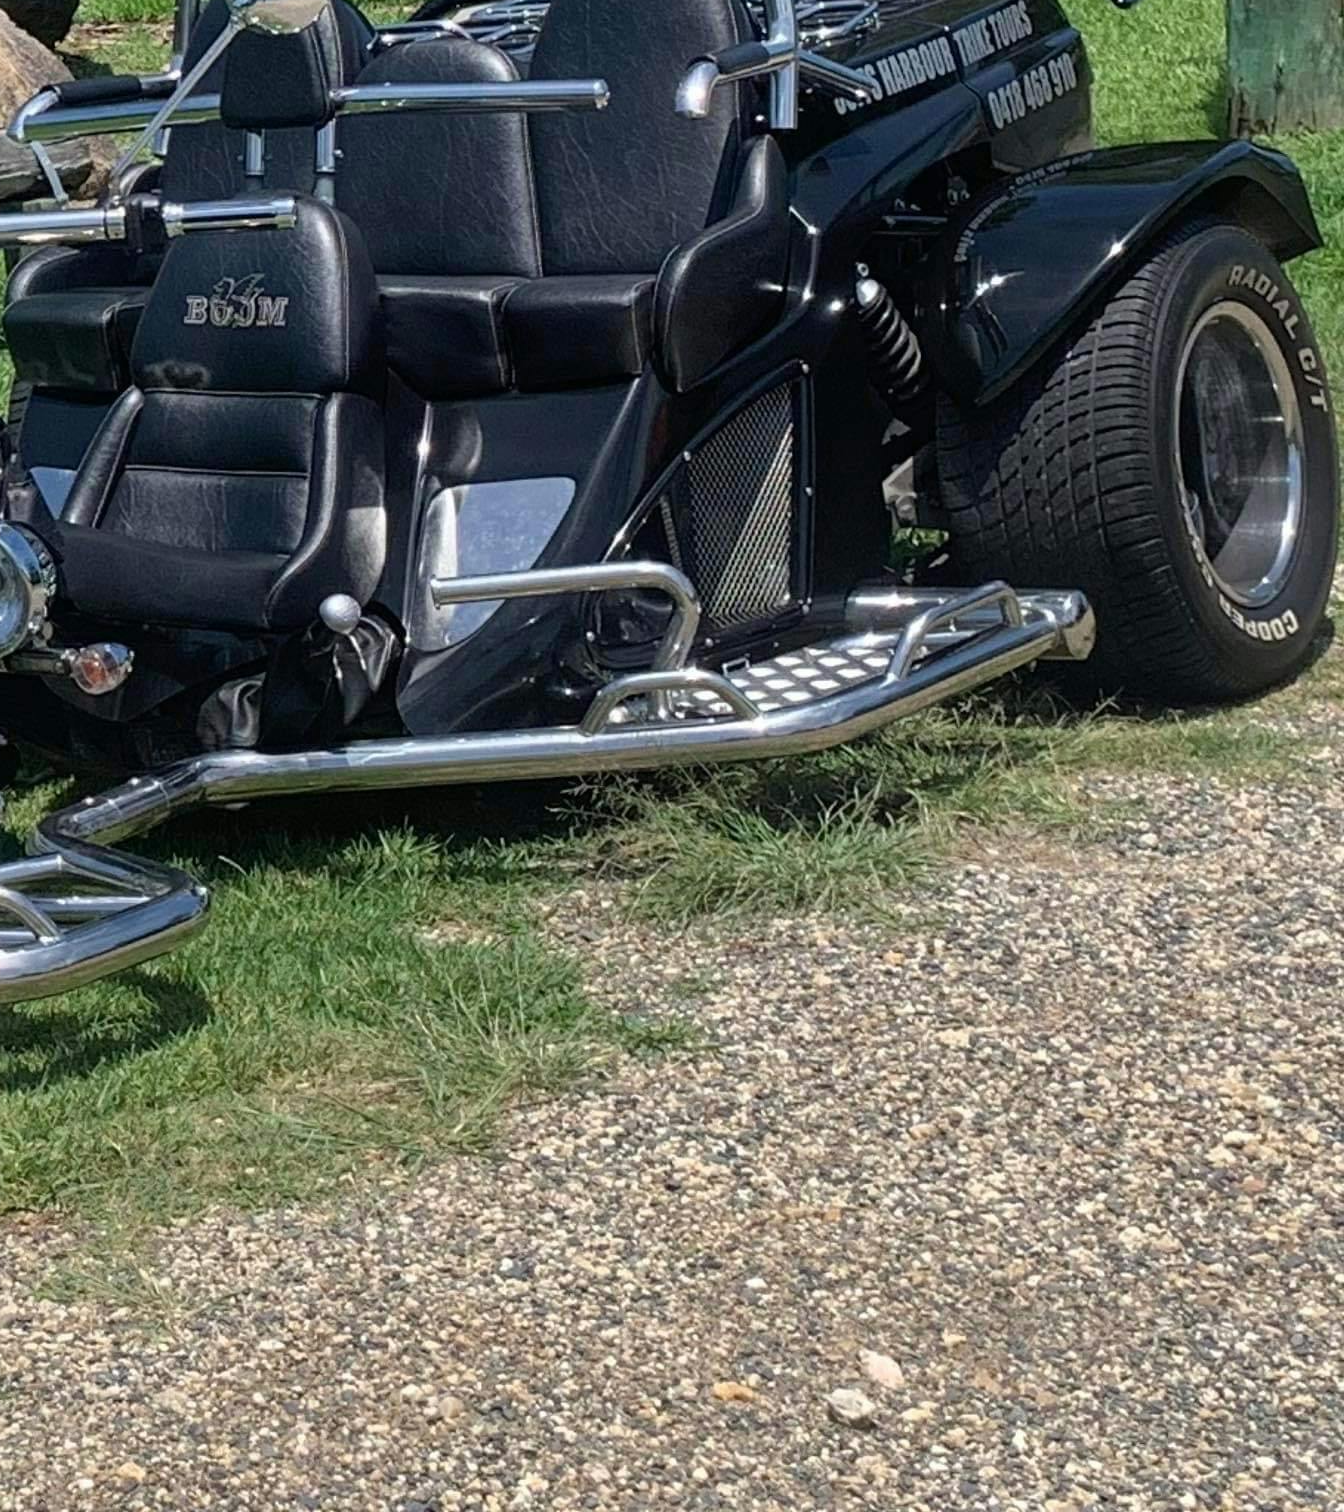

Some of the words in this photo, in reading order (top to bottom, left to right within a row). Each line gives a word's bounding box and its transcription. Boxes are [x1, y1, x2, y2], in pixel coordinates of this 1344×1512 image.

[876, 37, 956, 96] HARBOUR
[953, 18, 996, 66] TRIKE
[988, 0, 1032, 50] TOURS
[988, 80, 1026, 129] 0418
[1023, 66, 1053, 110] 468
[1048, 52, 1077, 96] 910
[1229, 265, 1298, 339] RADIAL
[1298, 347, 1328, 412] G/T
[1218, 593, 1299, 641] COOPER
